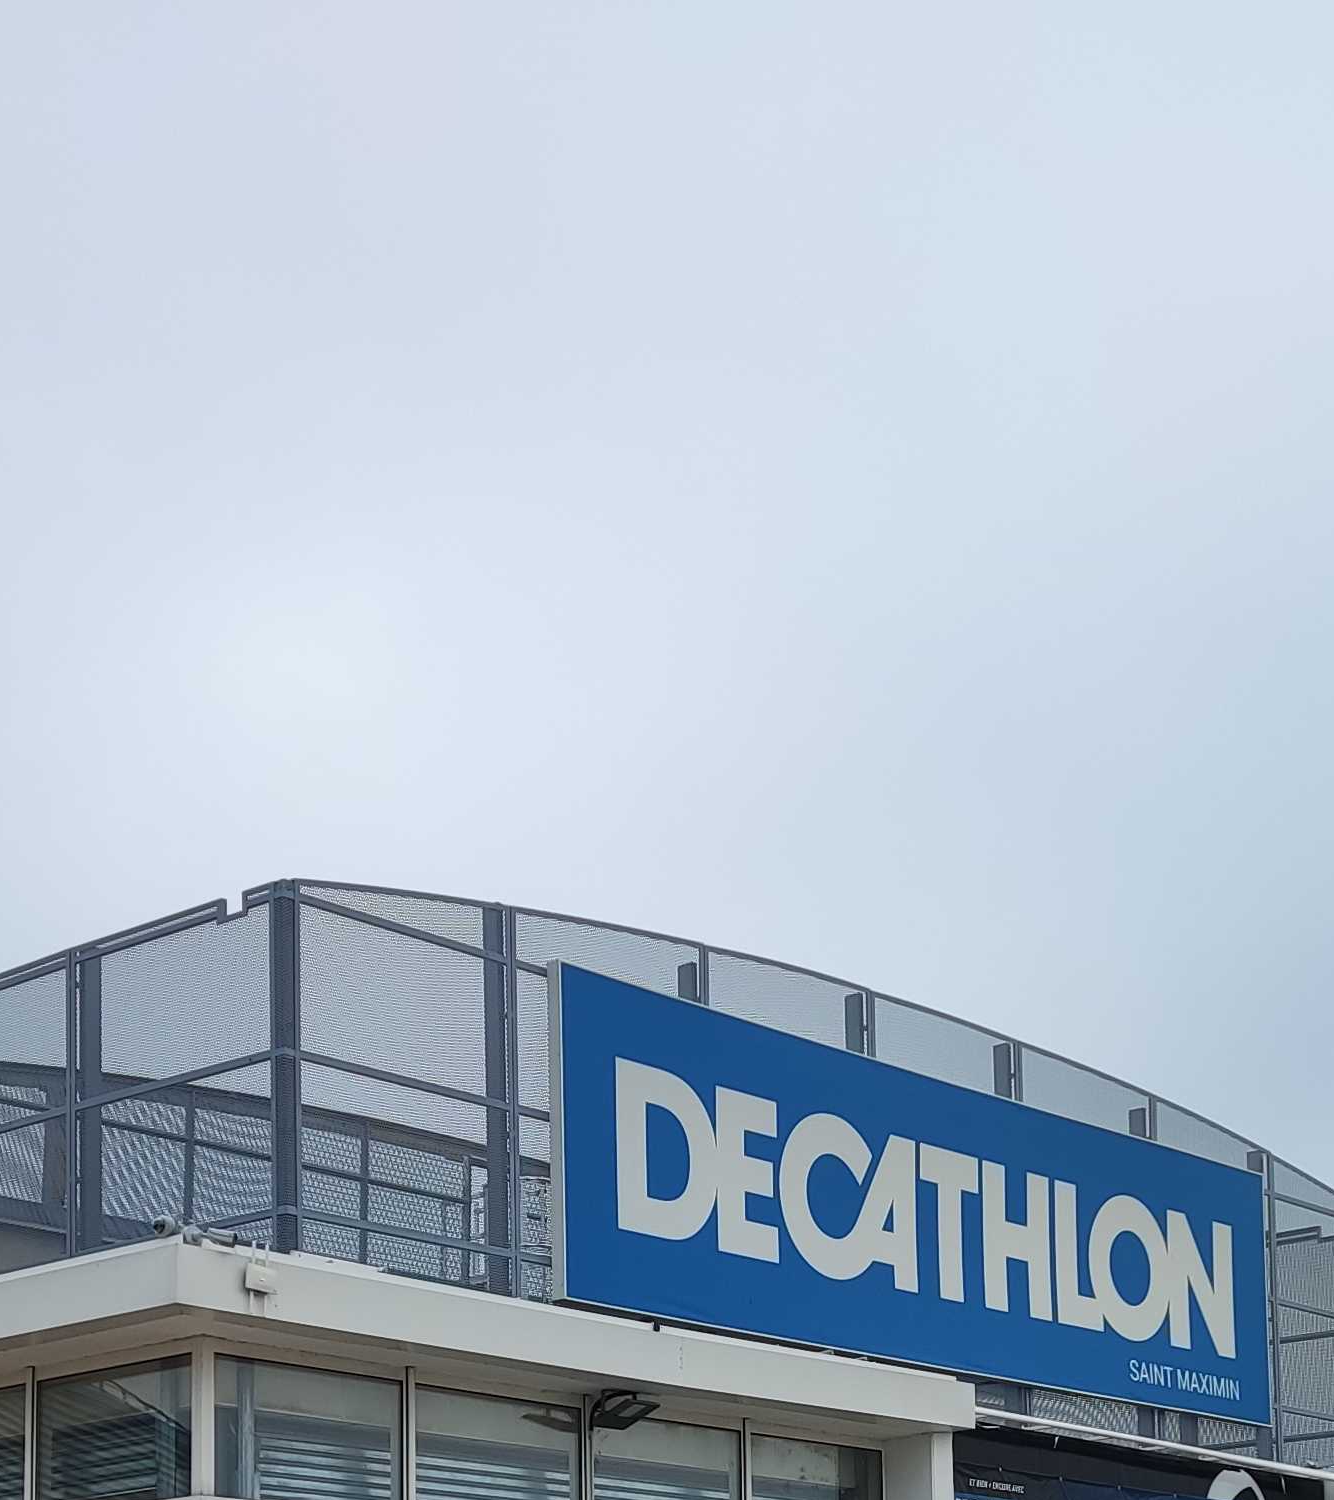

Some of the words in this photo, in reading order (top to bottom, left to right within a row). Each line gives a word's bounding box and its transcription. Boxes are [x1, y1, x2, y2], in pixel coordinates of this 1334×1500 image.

[613, 1055, 1237, 1360] DECATHLON
[1129, 1359, 1173, 1389] SAINT
[1176, 1368, 1240, 1401] MAXIMIN
